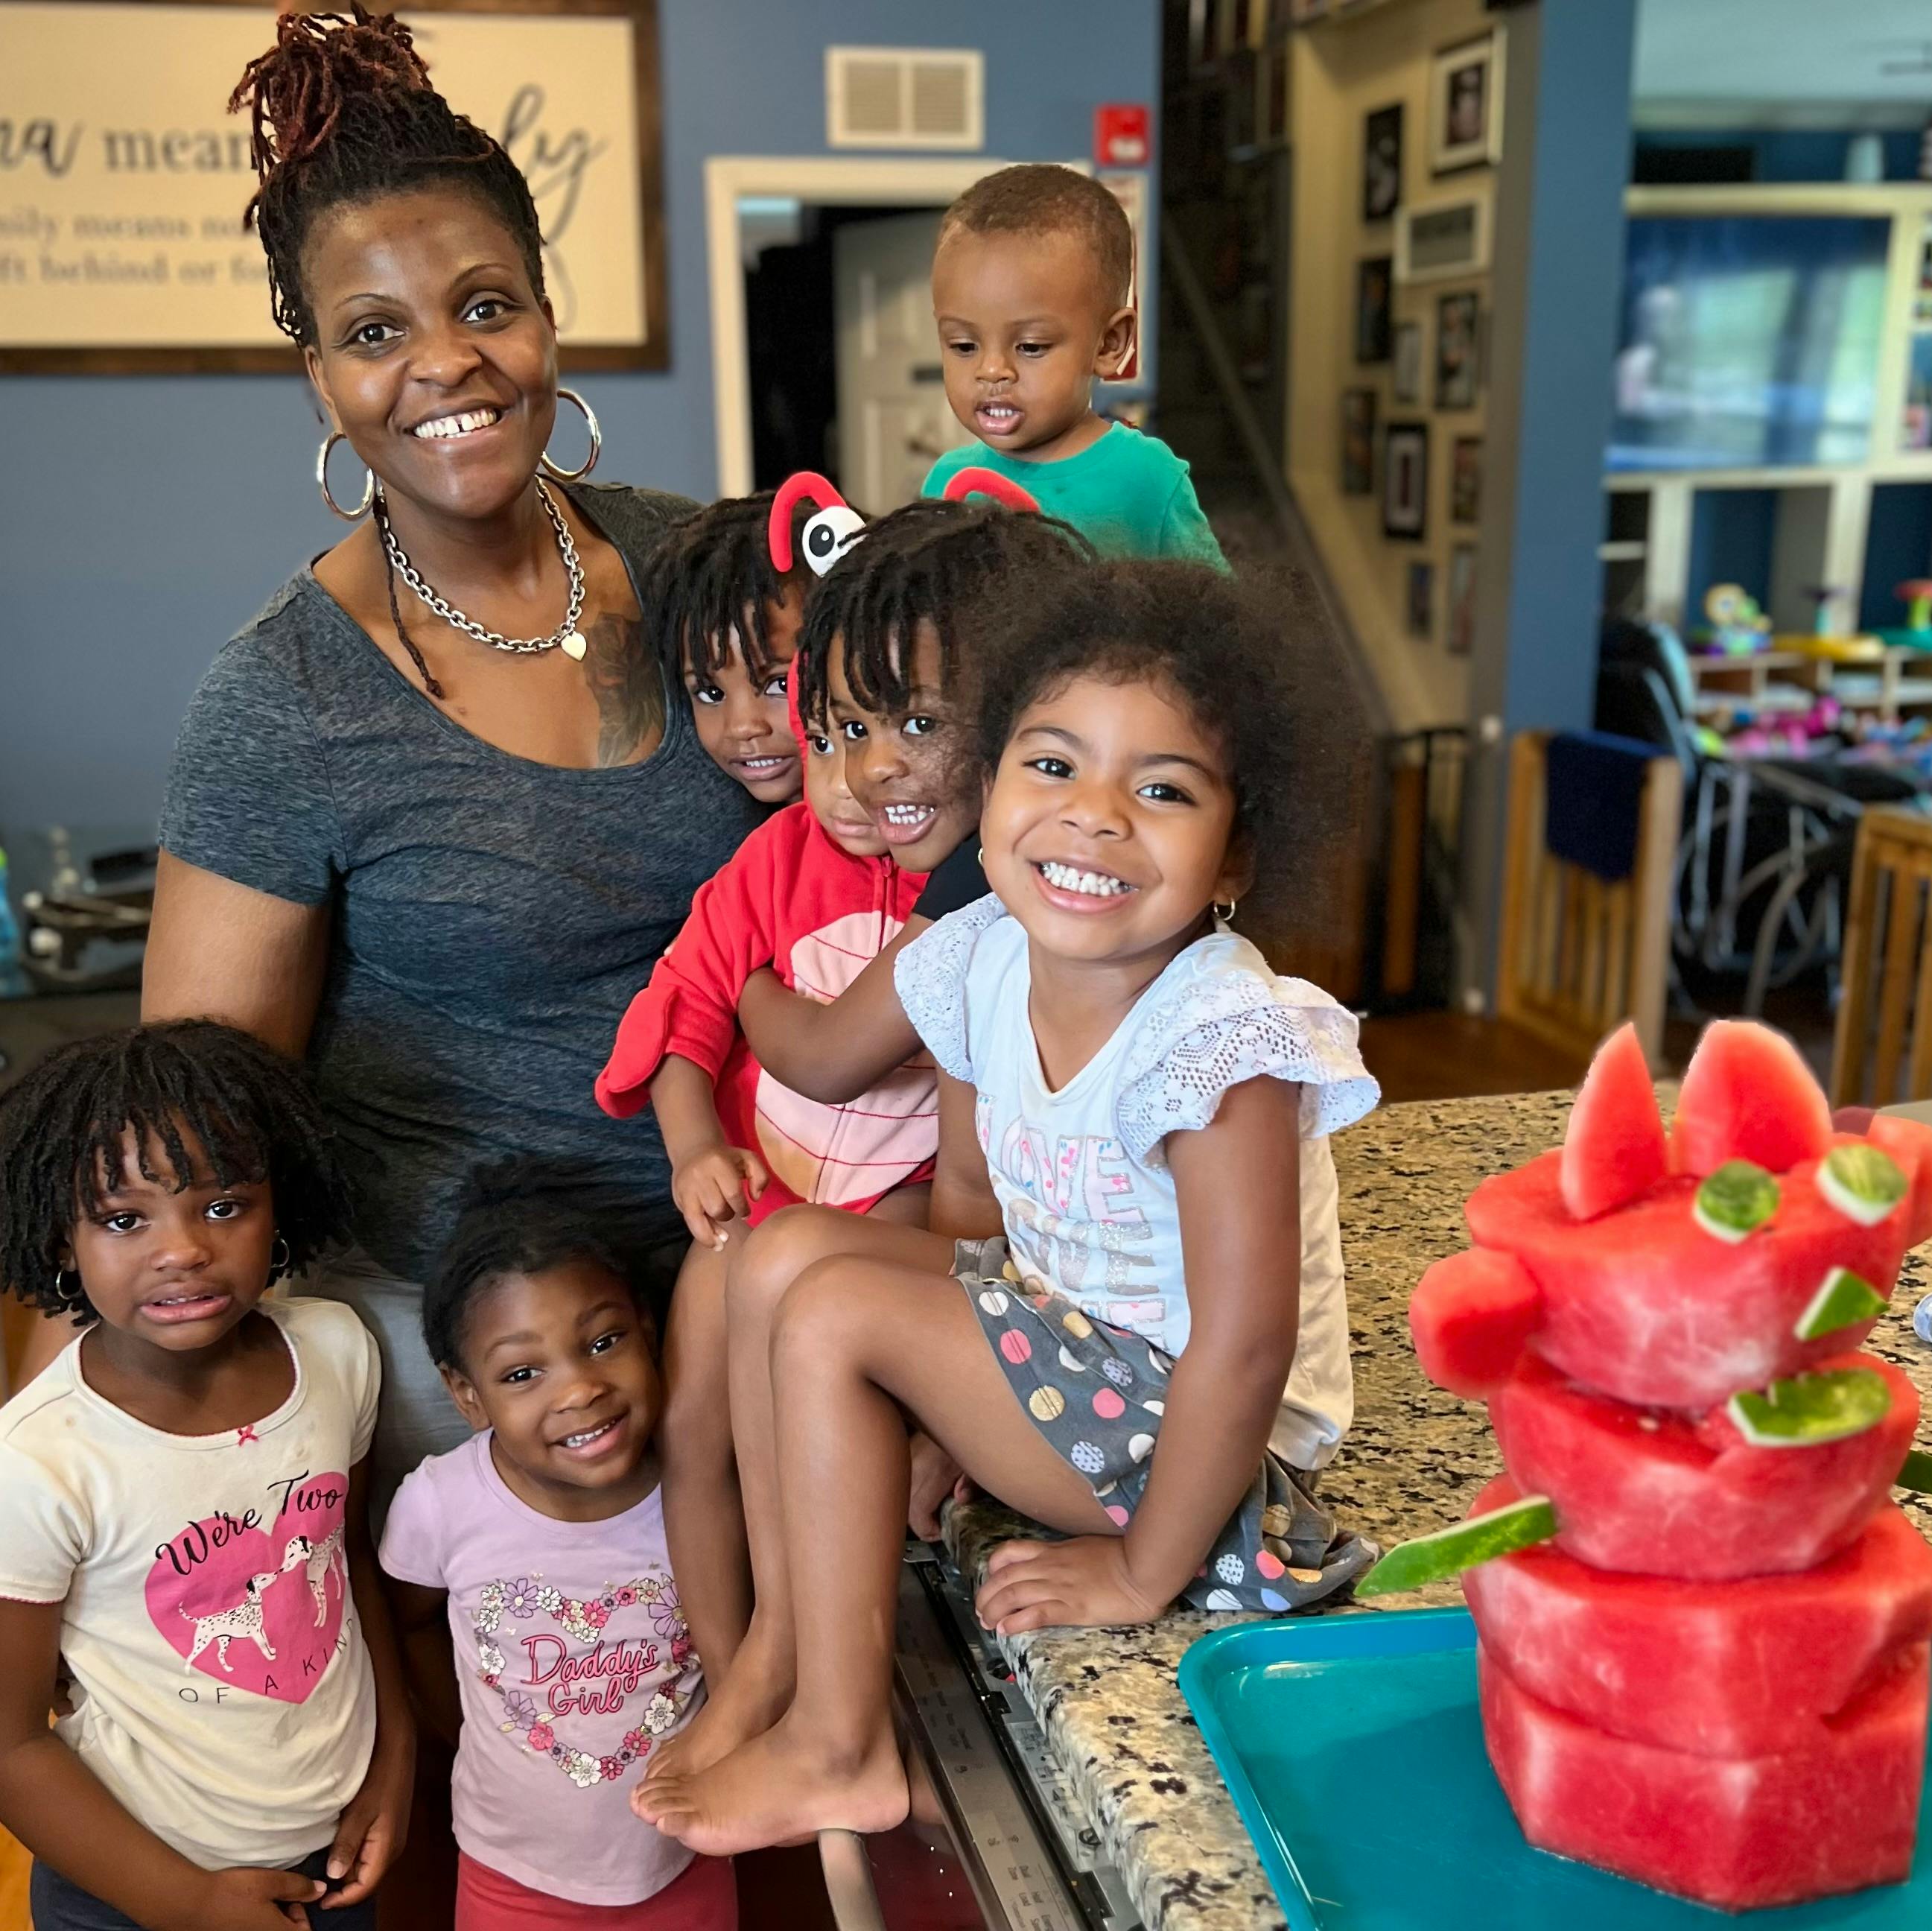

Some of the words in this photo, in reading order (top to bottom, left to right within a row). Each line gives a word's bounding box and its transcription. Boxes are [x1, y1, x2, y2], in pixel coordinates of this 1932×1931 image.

[103, 128, 261, 173] mean
[155, 1508, 263, 1576] We're
[267, 1469, 343, 1516] Two
[521, 1634, 660, 1693] Daddy's
[179, 1687, 230, 1704] OF
[265, 1674, 279, 1695] A
[548, 1677, 624, 1716] Girl
